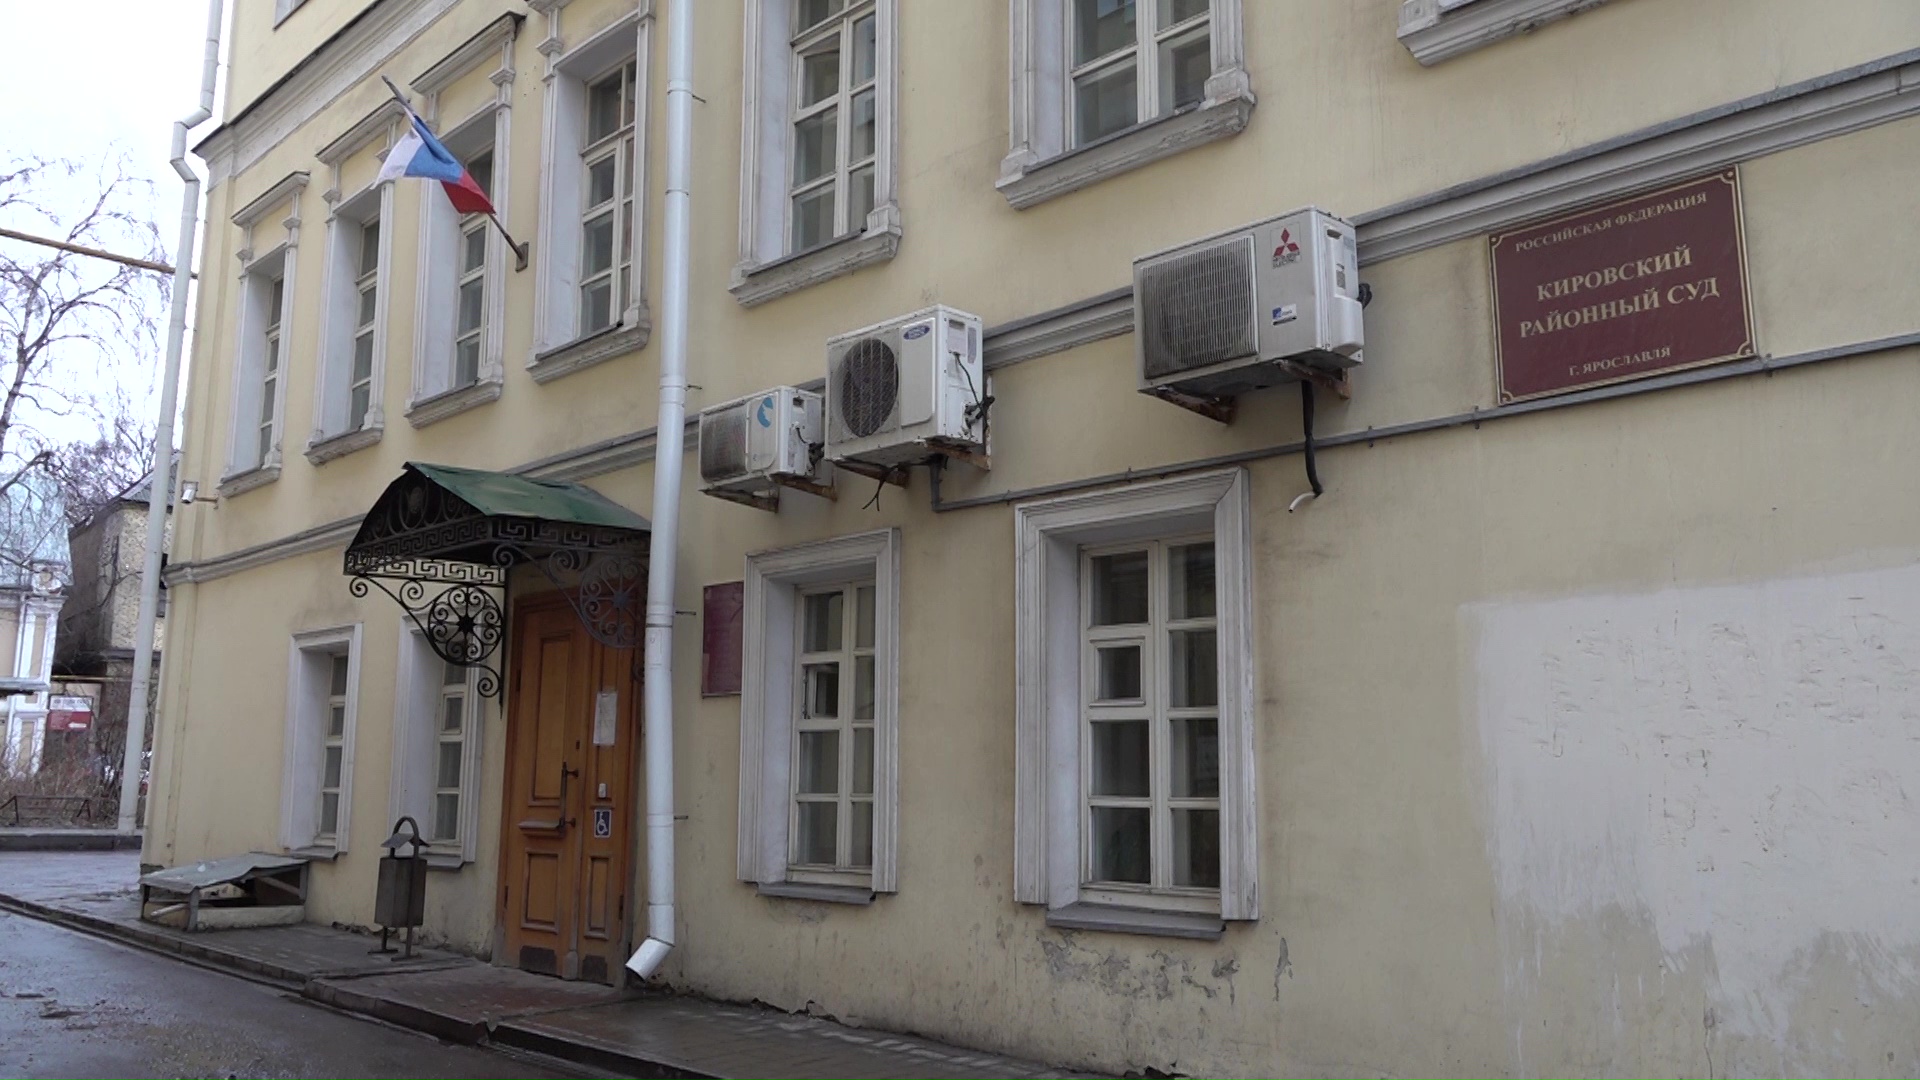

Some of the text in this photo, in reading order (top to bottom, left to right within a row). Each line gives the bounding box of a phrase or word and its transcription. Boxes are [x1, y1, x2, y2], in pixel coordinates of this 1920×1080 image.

[1516, 192, 1708, 252] РОССИЙСКАЯ ФЕДЕРАЦИЯ
[1537, 244, 1692, 302] КИРОВСКИЙ
[1520, 277, 1720, 338] РАЙОННЫЙ СУД
[1583, 347, 1671, 375] ЯРОСЛАВЛЯ
